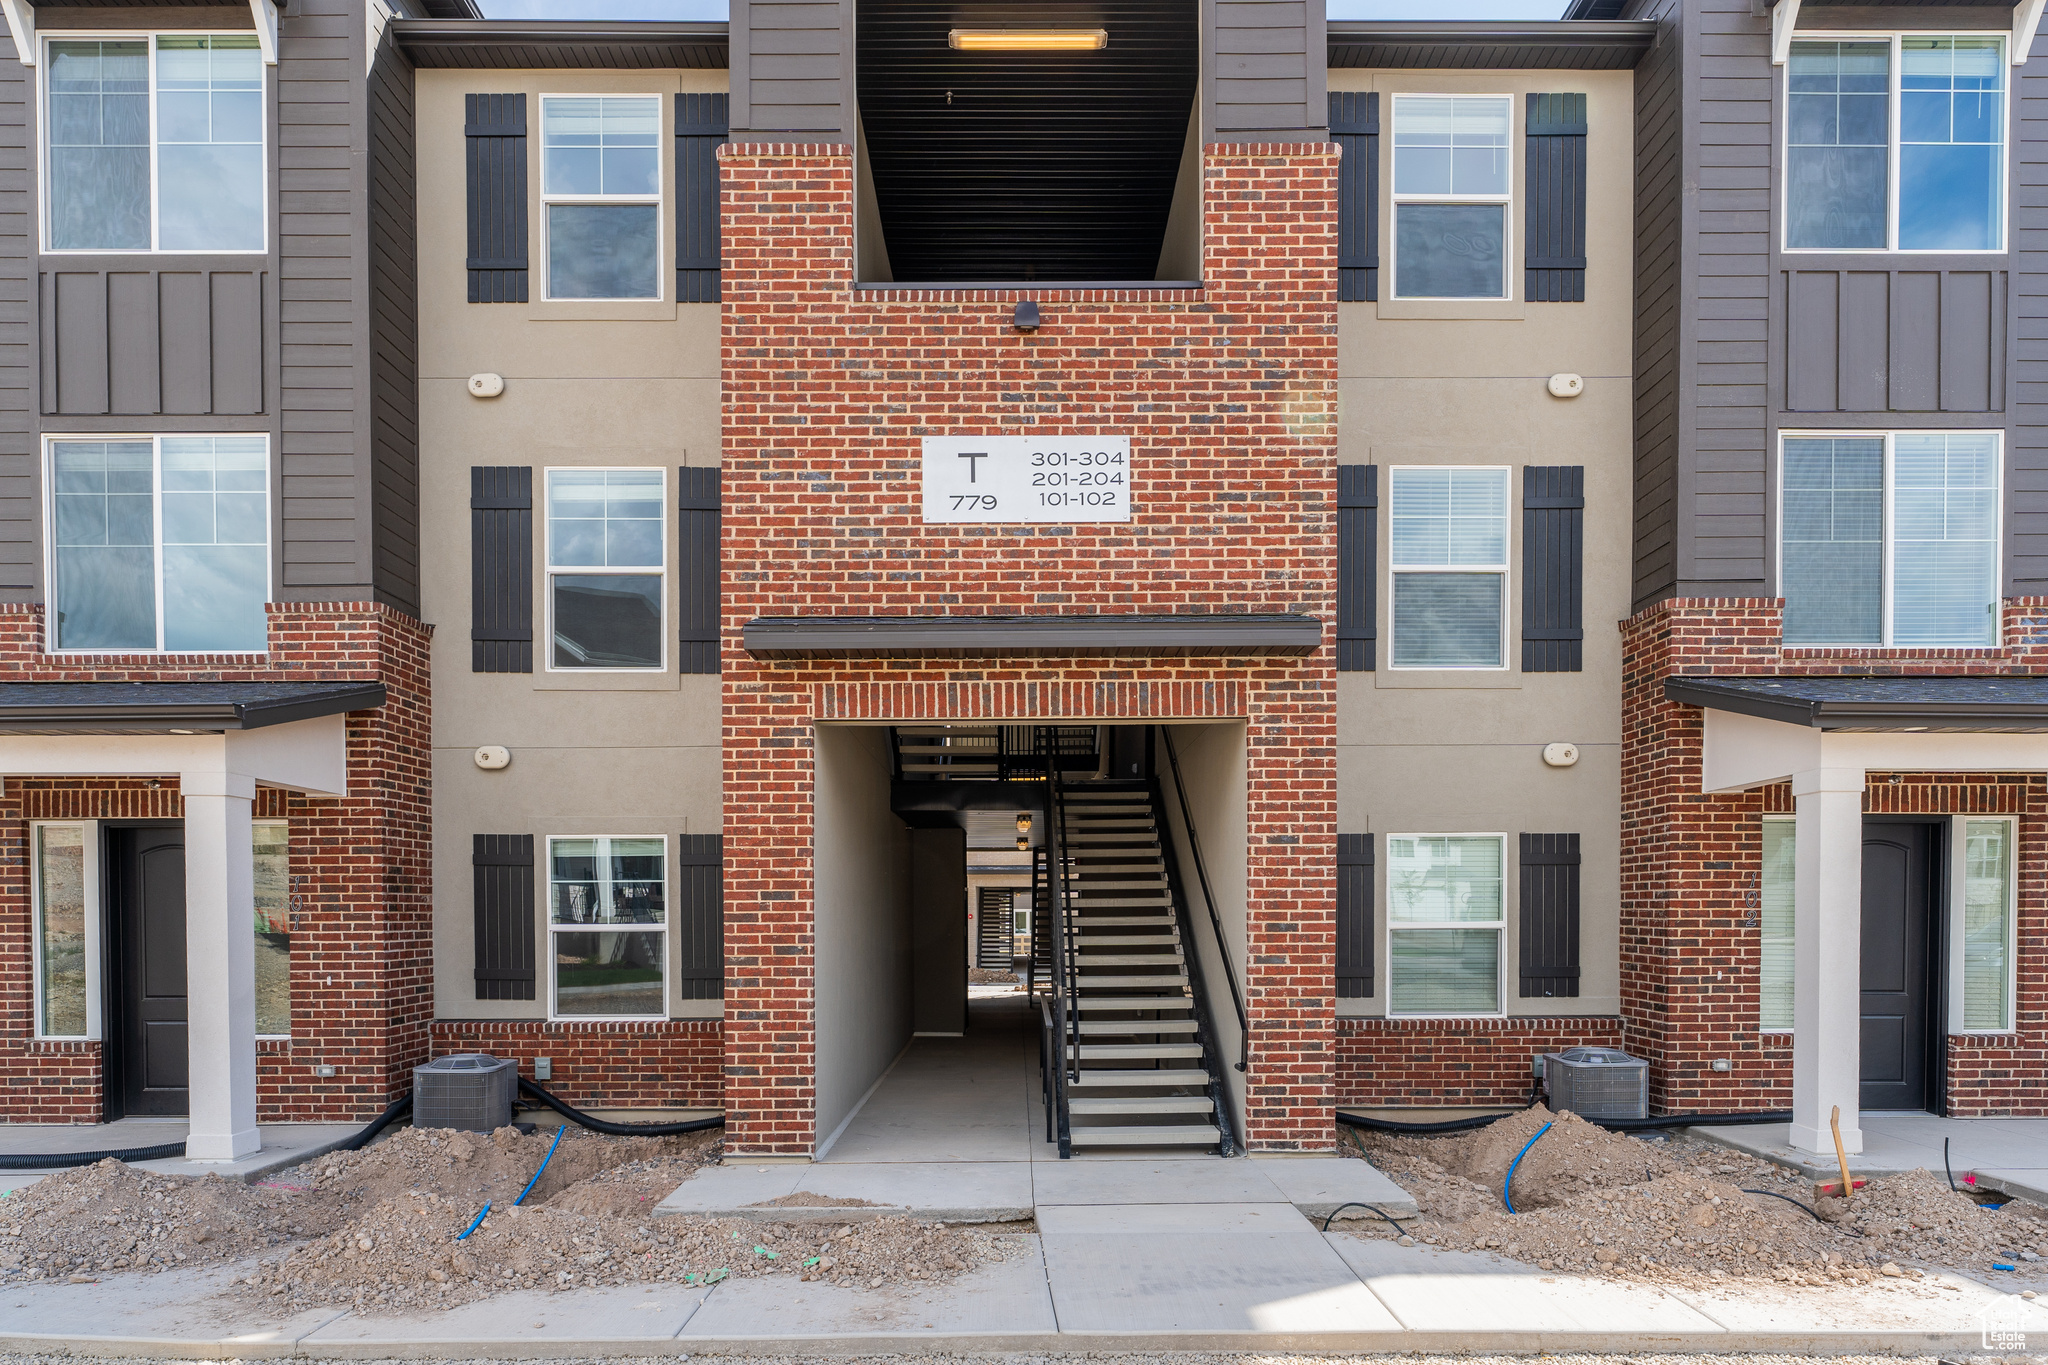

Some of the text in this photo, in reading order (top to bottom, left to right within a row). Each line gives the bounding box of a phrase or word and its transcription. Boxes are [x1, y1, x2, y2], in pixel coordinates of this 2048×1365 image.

[1031, 452, 1124, 466] 301-304
[958, 453, 988, 483] T
[1032, 472, 1124, 486] 201-204
[949, 495, 997, 510] 779
[1040, 492, 1116, 506] 101-102
[291, 875, 303, 931] 101
[1745, 871, 1757, 927] 102
